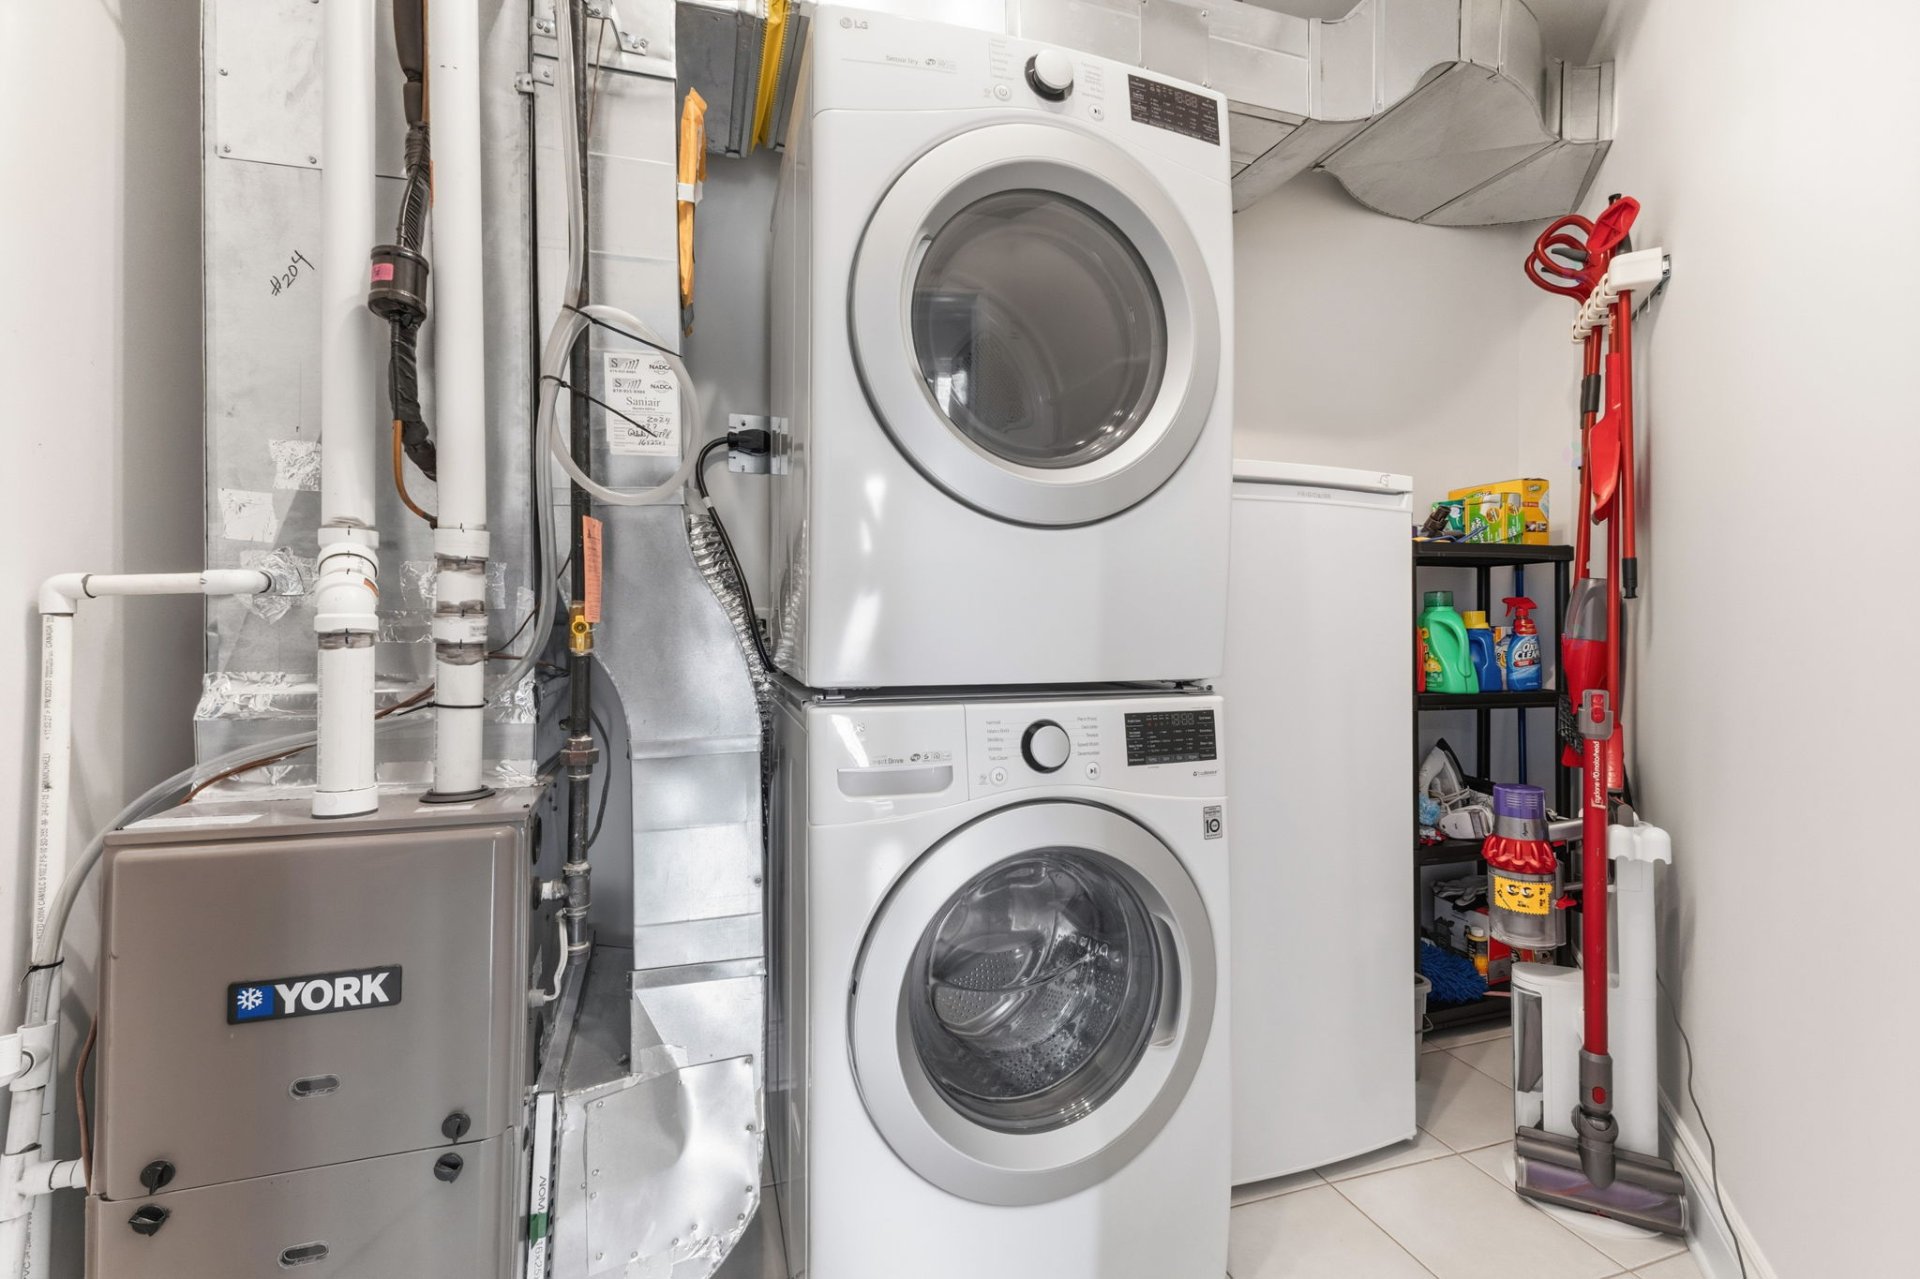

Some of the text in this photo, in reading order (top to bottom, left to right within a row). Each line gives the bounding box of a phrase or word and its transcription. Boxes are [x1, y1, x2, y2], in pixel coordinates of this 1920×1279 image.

[854, 22, 869, 30] LG
[270, 249, 315, 296] #204
[626, 396, 660, 407] Saniair
[275, 972, 390, 1015] YORK
